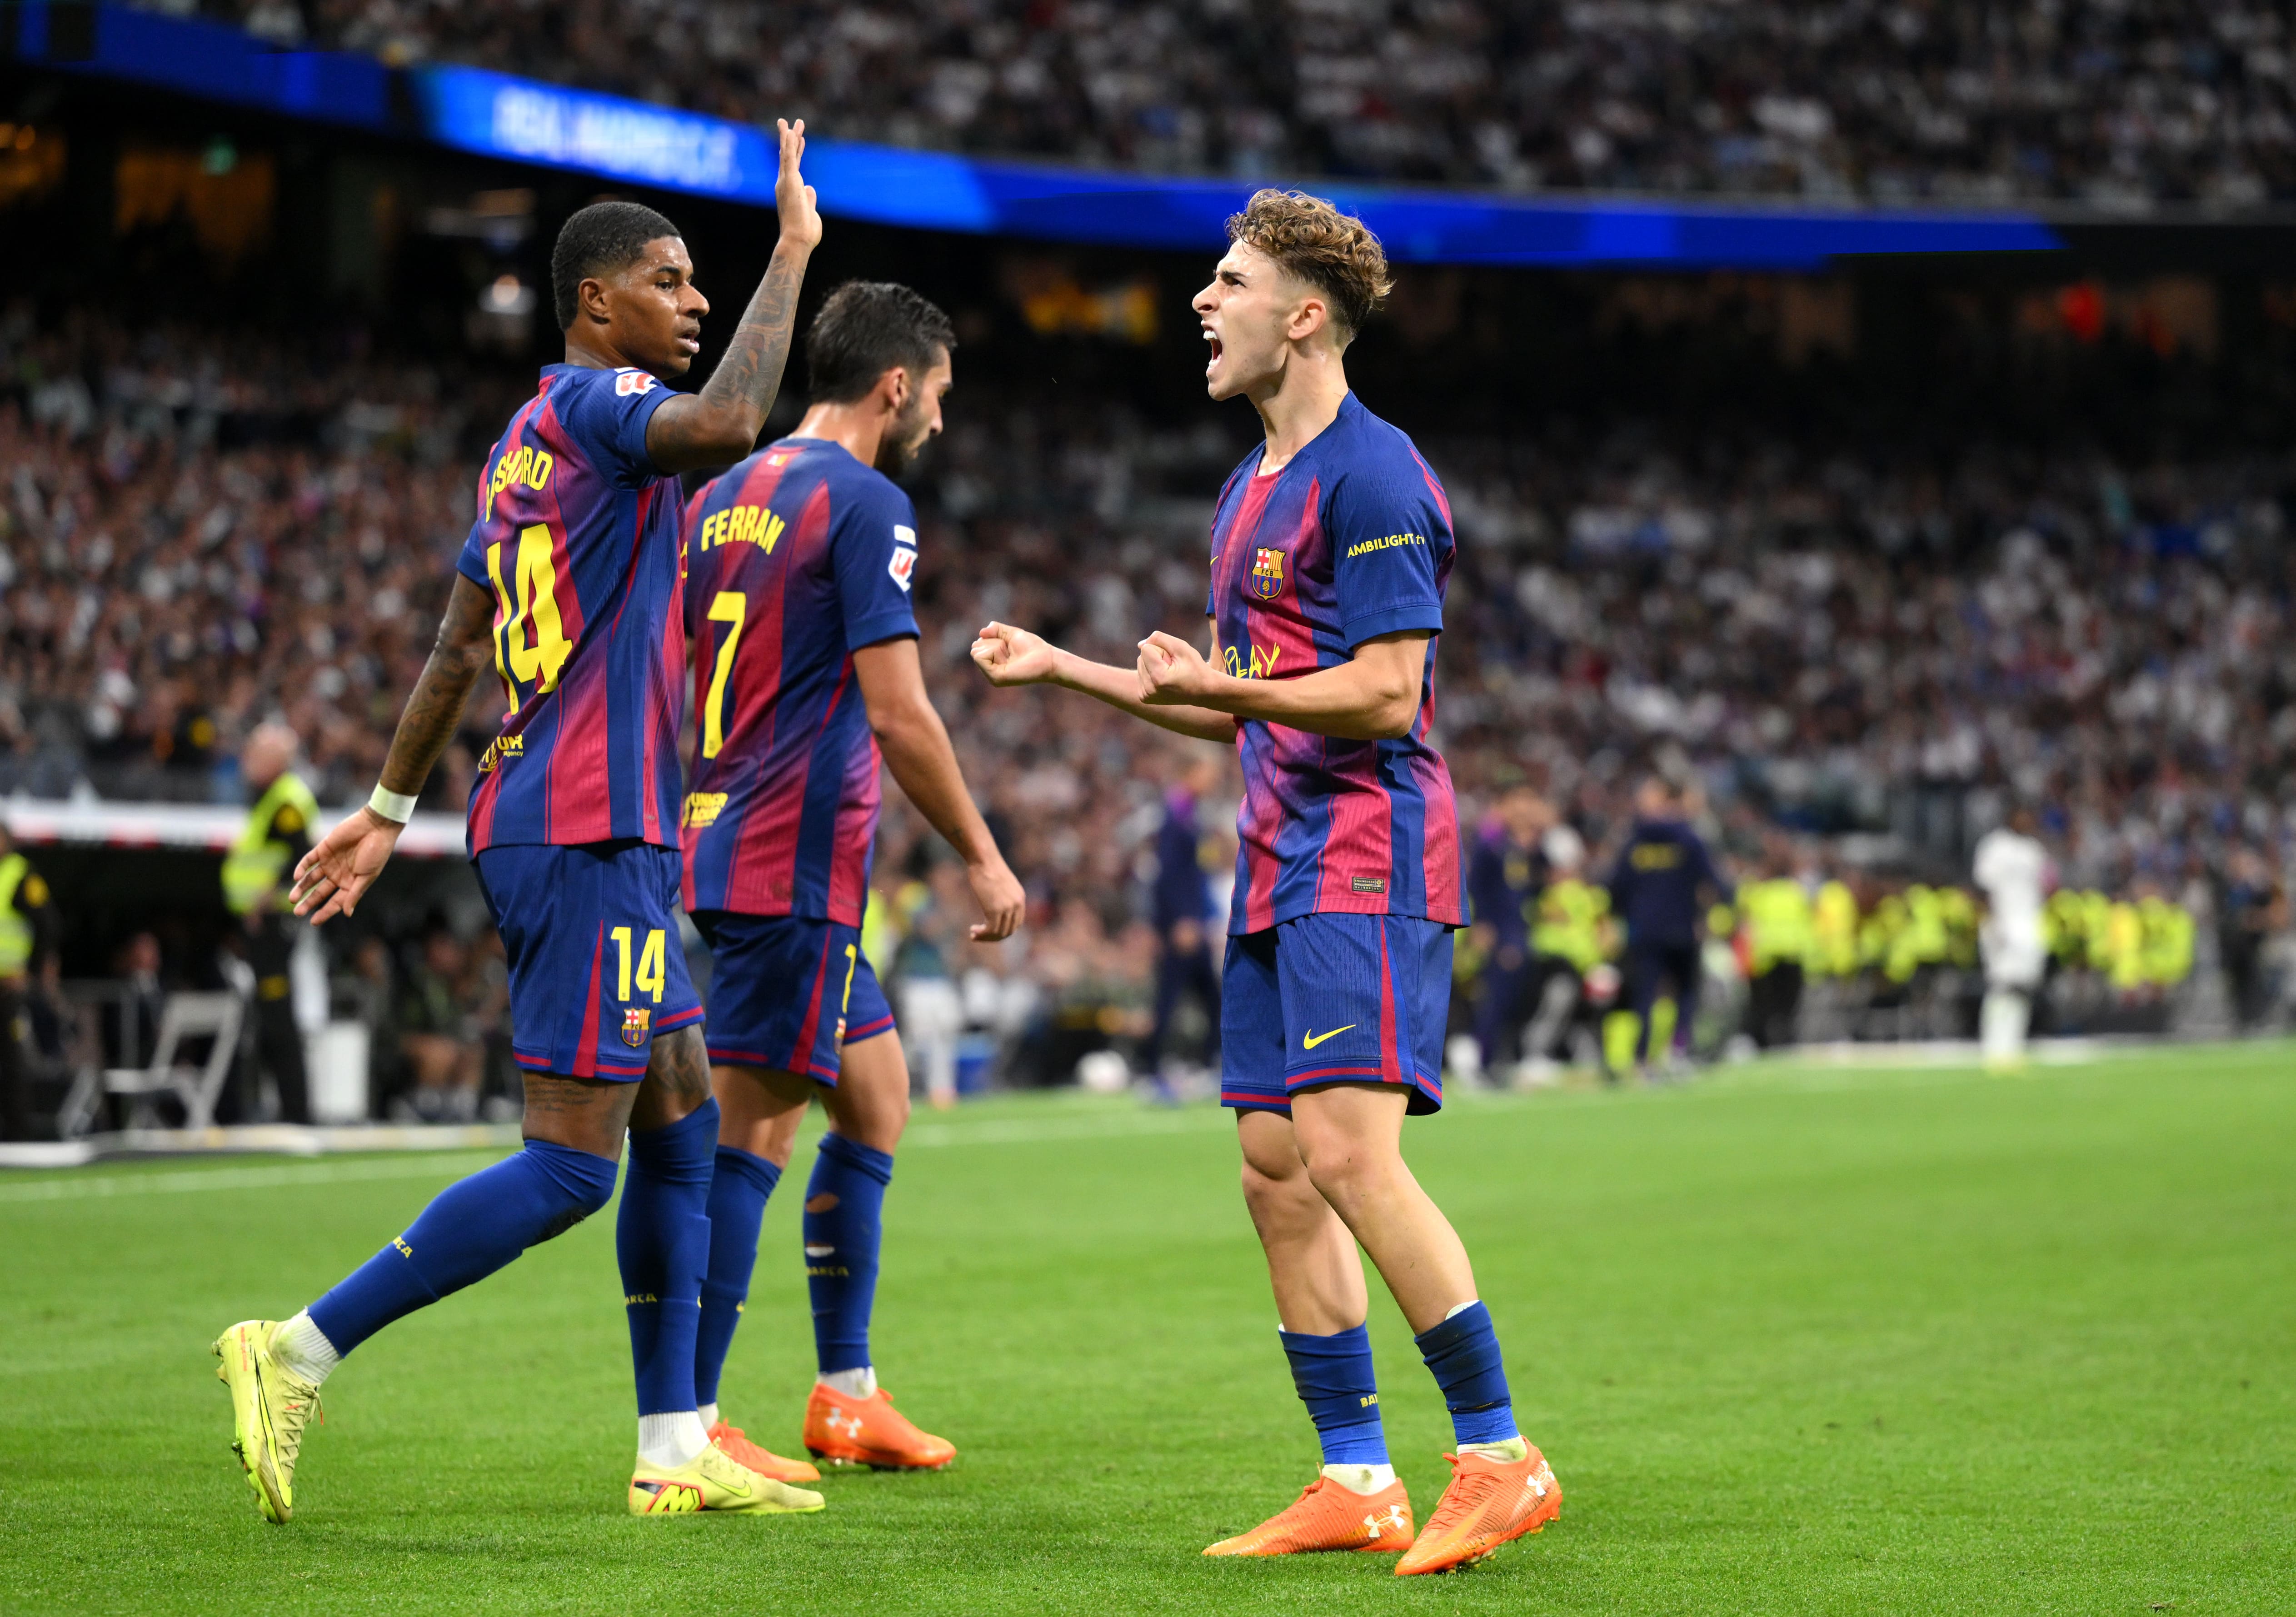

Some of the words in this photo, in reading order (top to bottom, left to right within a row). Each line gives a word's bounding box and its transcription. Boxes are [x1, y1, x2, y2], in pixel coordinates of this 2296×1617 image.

[701, 505, 785, 555] FERRAN
[1347, 533, 1414, 558] AMBILIGHT
[1415, 534, 1425, 545] tv
[487, 523, 573, 715] 14
[703, 591, 746, 759] 7
[1225, 642, 1280, 679] PLAY
[611, 926, 665, 1003] 14
